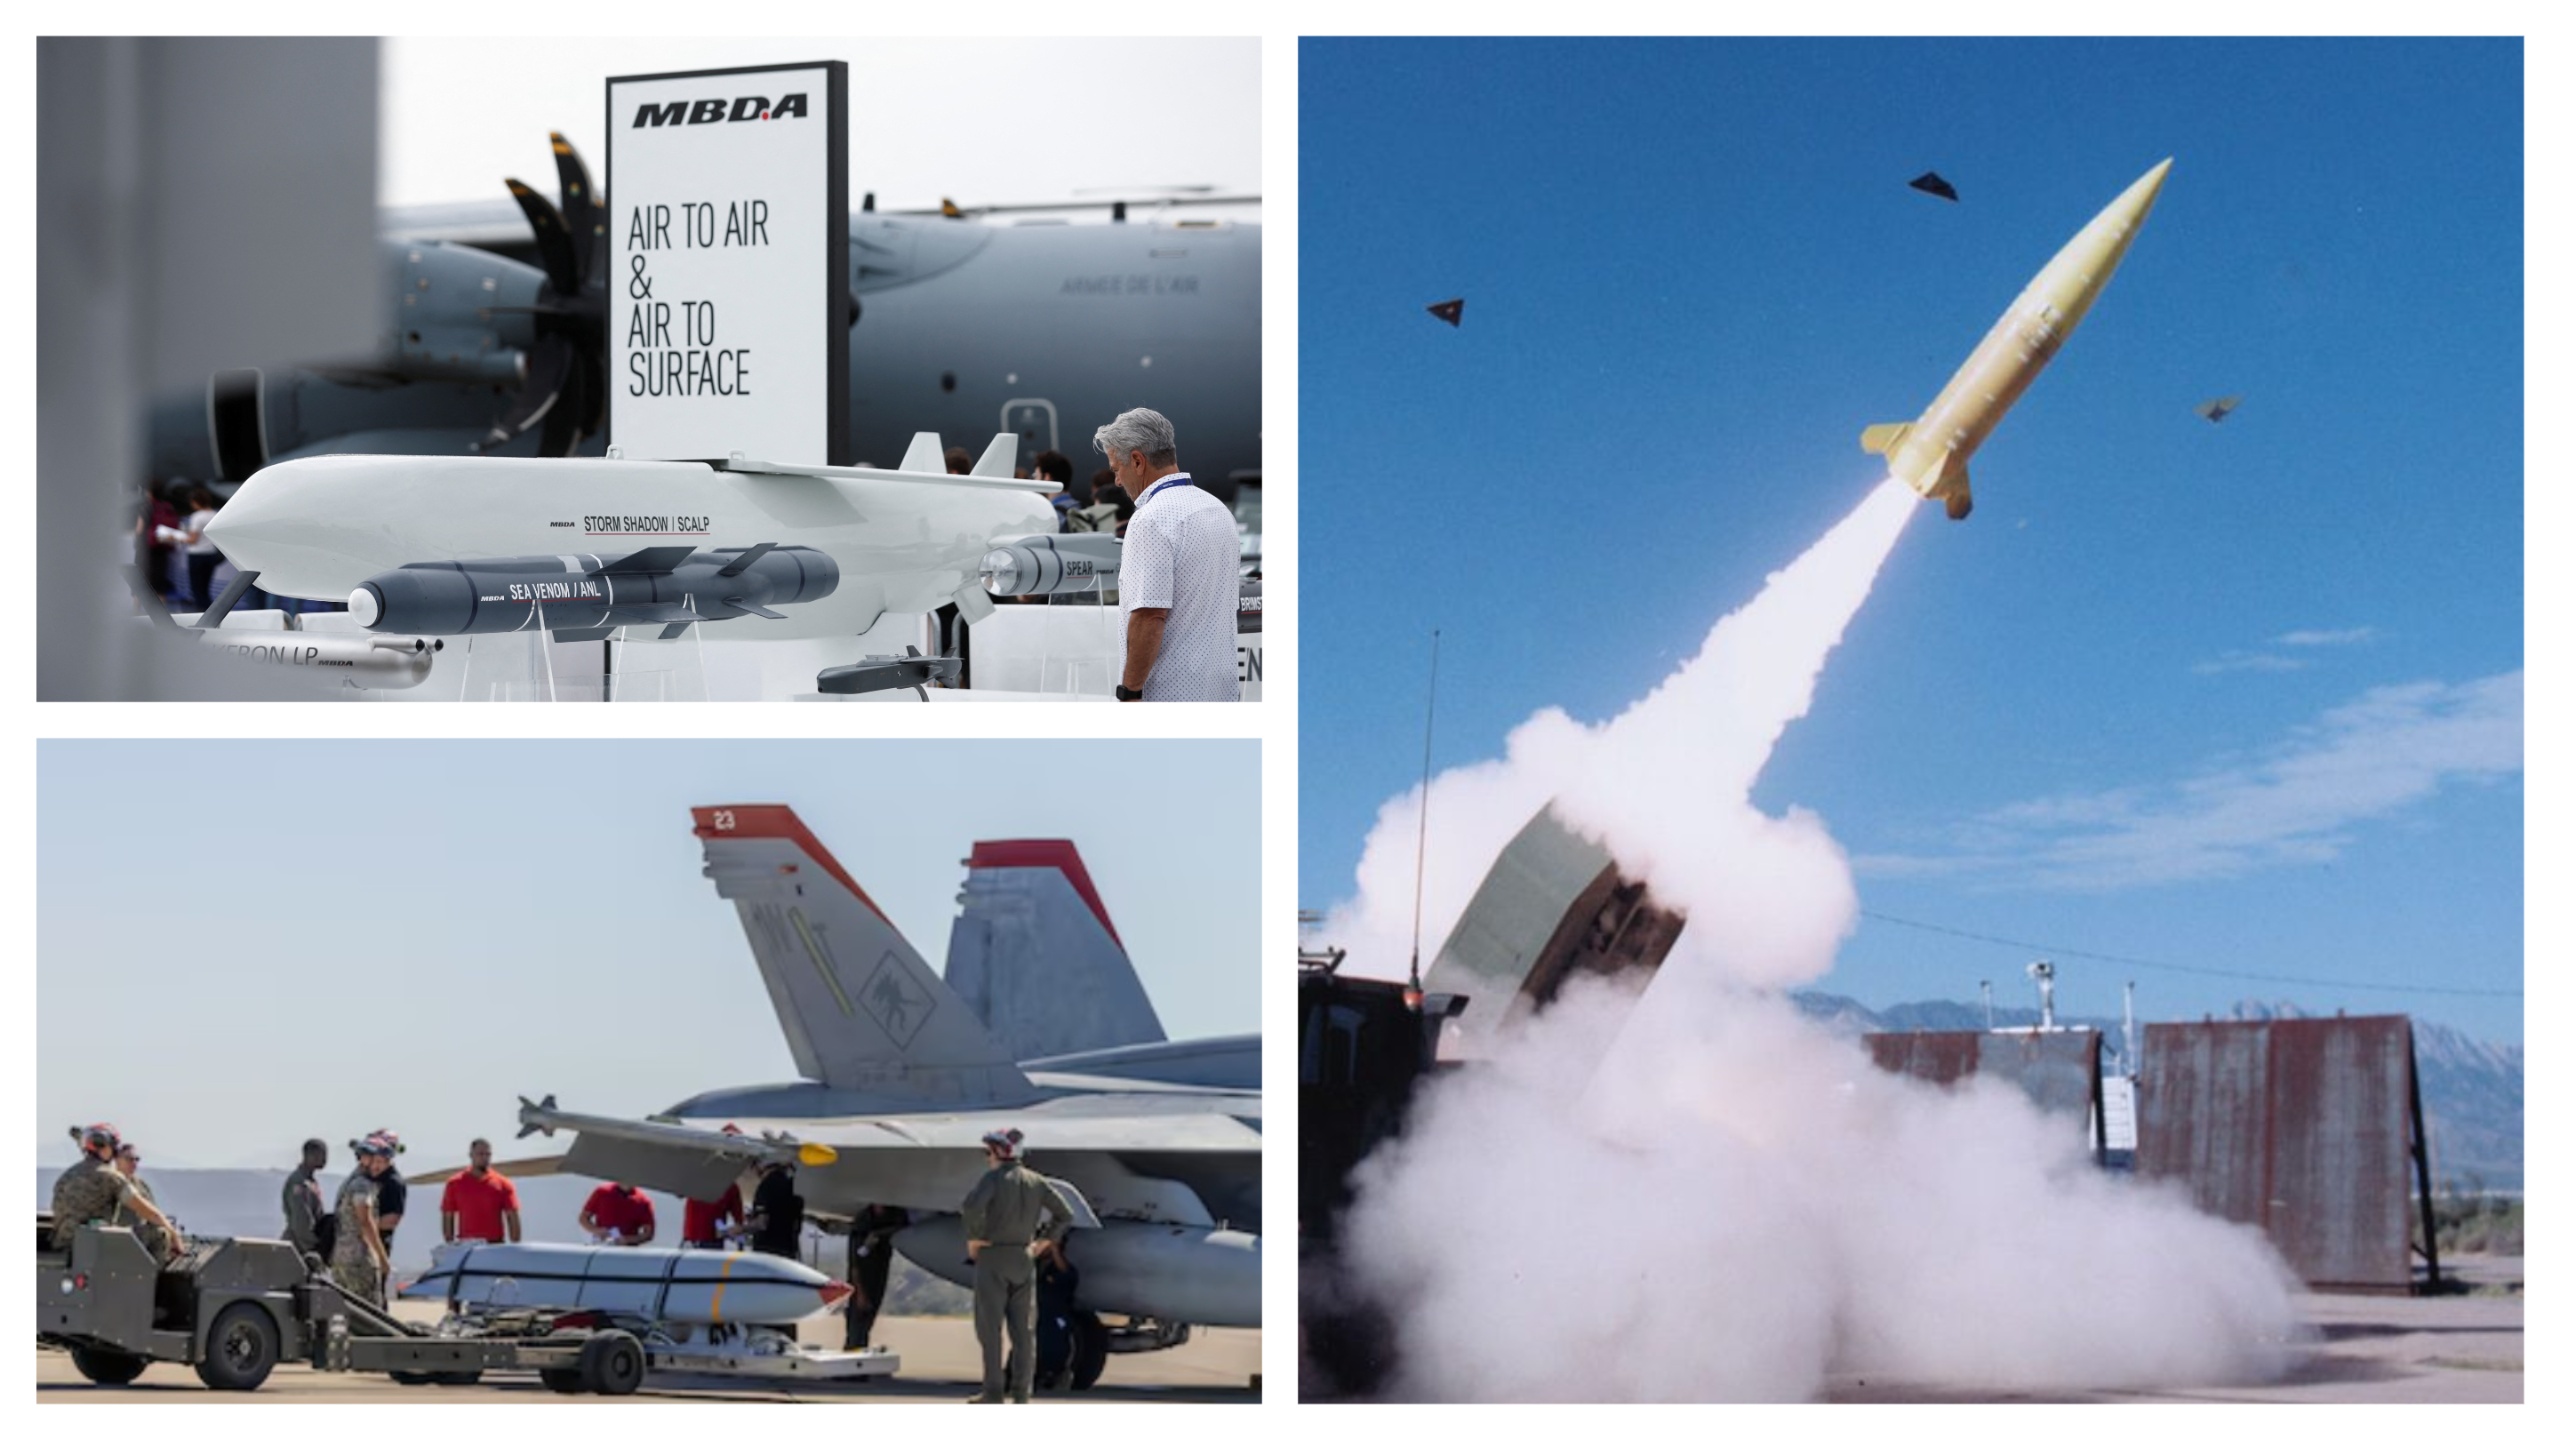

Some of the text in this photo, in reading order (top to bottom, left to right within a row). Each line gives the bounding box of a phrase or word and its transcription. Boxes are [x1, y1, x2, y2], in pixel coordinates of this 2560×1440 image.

[632, 93, 808, 128] MBDA
[628, 200, 769, 251] AIR TO AIR
[629, 254, 653, 300] &
[628, 300, 714, 348] AIR TO
[629, 349, 750, 397] SURFACE
[584, 516, 622, 532] STORM
[624, 516, 668, 532] SHADOW
[678, 516, 710, 532] SCALP
[1066, 561, 1093, 576] SPEAR
[510, 584, 532, 600] SEA
[532, 582, 570, 599] VENOM
[580, 580, 602, 598] ANL
[293, 647, 318, 666] LP
[713, 810, 735, 830] 23
